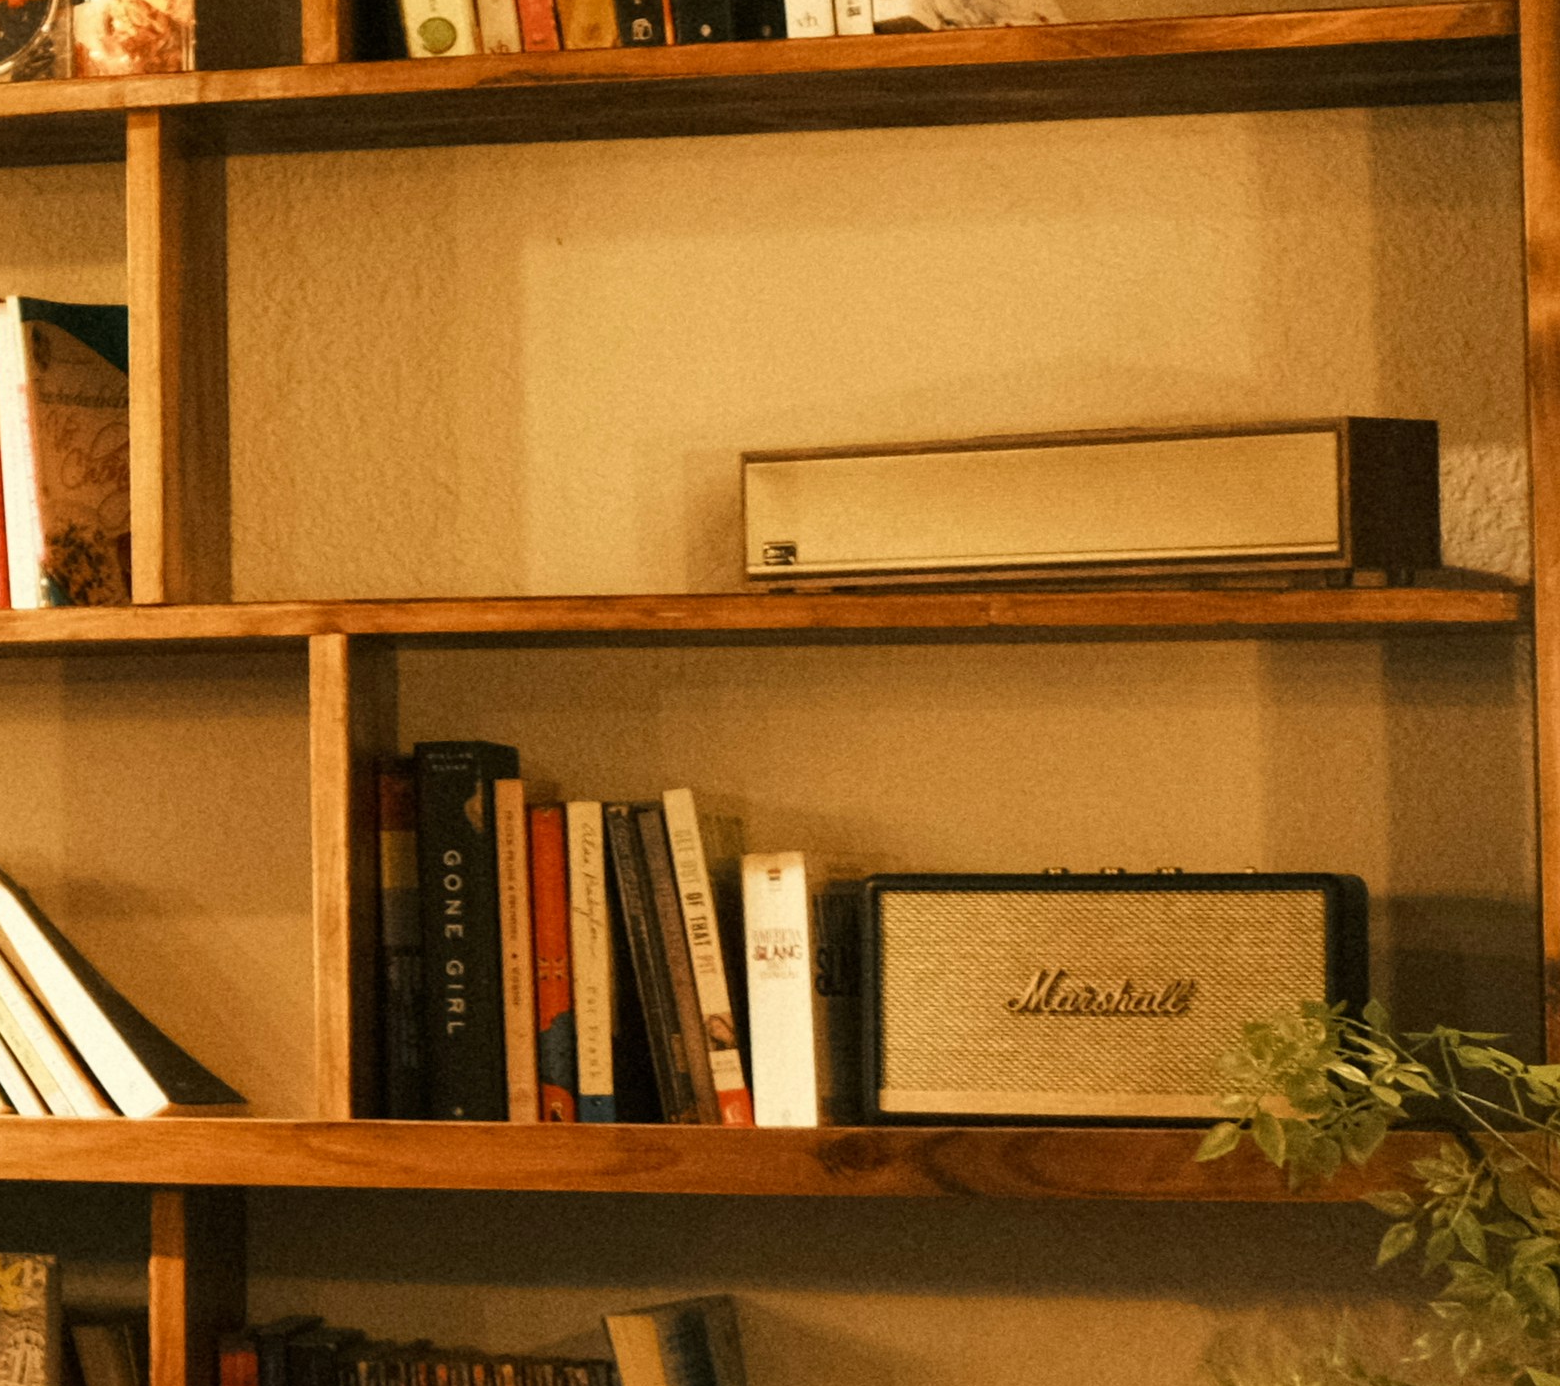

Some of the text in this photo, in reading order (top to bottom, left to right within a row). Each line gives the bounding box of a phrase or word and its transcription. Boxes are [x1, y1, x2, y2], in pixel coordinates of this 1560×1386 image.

[683, 889, 706, 909] OF
[442, 849, 466, 1034] GONE GIRL
[687, 914, 712, 950] THAT
[752, 944, 803, 961] SLANG
[1006, 967, 1199, 1017] Marshall
